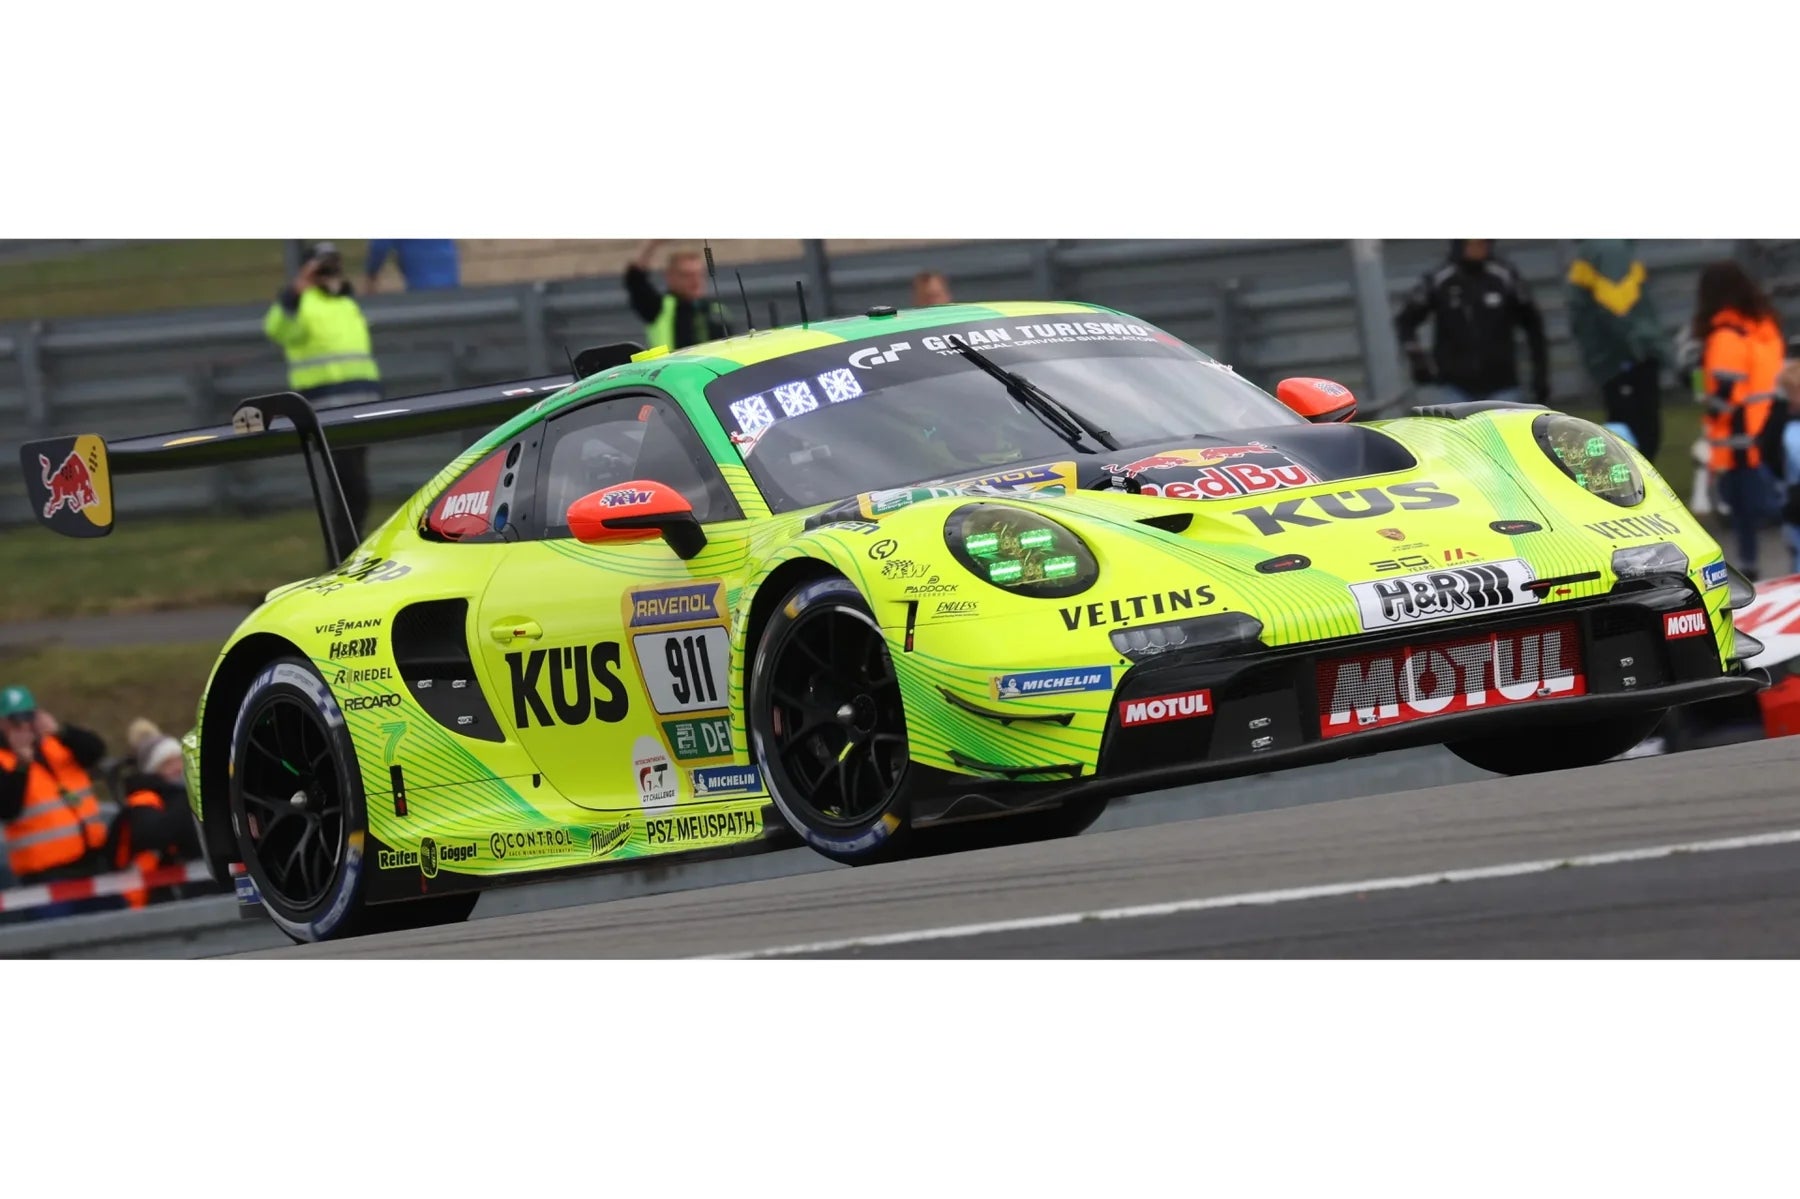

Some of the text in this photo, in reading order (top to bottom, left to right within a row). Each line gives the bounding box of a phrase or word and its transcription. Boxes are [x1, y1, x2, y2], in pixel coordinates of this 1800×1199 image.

[441, 491, 490, 520] MOTUL
[604, 489, 655, 508] KW
[1232, 482, 1460, 536] KÜS
[1584, 513, 1680, 539] VELTINS
[904, 584, 959, 593] PADDOCK
[636, 594, 711, 617] RAVENOL
[936, 601, 978, 612] ENDLESS
[1060, 585, 1215, 631] VELTINS
[315, 618, 382, 637] VIESSMANN
[1667, 612, 1706, 636] MOTUL
[353, 667, 393, 682] RIEDEL
[665, 635, 718, 704] 911
[1329, 630, 1575, 726] MOTUL
[505, 641, 629, 729] KÜS
[1022, 674, 1102, 690] MICHELIN
[344, 693, 401, 711] RECARO
[1125, 694, 1208, 723] MOTUL
[708, 773, 755, 788] MICHELIN
[650, 789, 675, 801] CHALLENGE
[506, 830, 572, 848] CONTROL
[591, 820, 631, 855] Milwaukee
[646, 811, 756, 844] PSZ MEUSPATH
[380, 851, 417, 867] Reifen
[440, 843, 477, 862] Göggel
